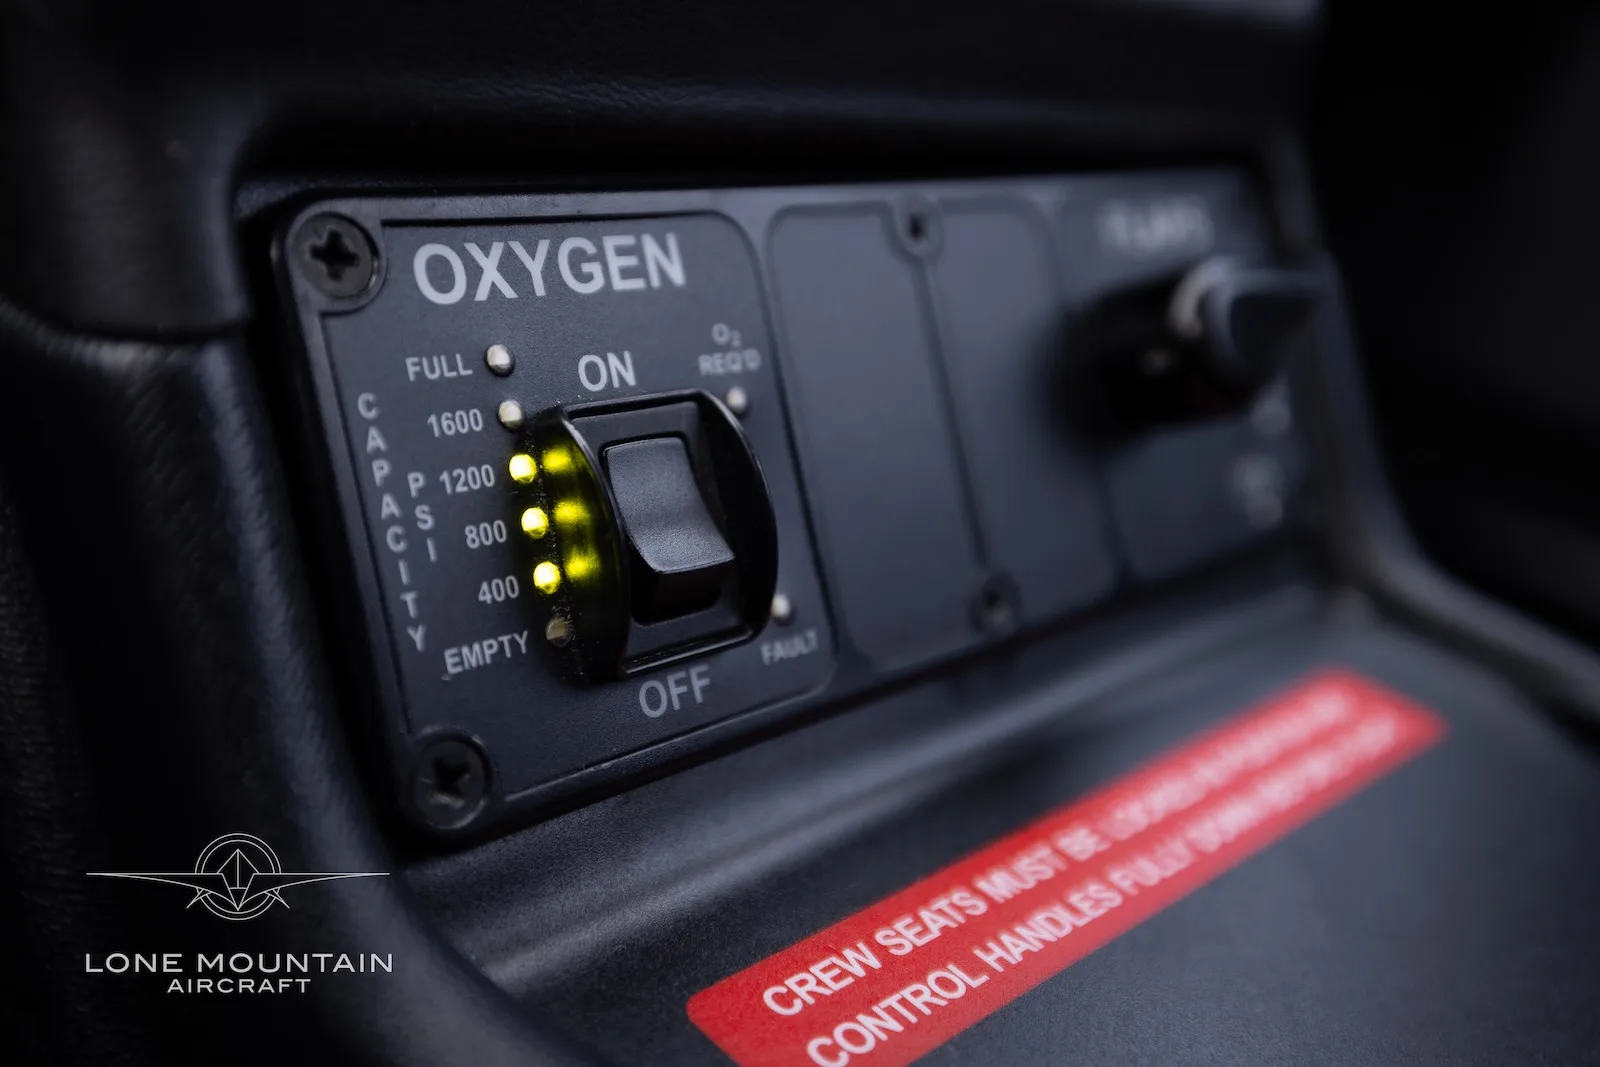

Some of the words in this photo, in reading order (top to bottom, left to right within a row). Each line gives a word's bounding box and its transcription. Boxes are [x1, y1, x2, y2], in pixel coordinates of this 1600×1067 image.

[413, 232, 686, 305] OXYGEN
[406, 353, 473, 382] FULL
[577, 350, 637, 391] ON
[427, 408, 484, 437] 1600
[439, 464, 496, 495] 1200
[464, 520, 508, 549] 800
[478, 575, 519, 604] 400
[443, 630, 530, 675] EMPTY
[760, 631, 819, 665] FAULT
[638, 665, 712, 718] OFF
[763, 942, 882, 1016] CREW
[874, 886, 988, 956] SEATS
[972, 842, 1067, 904] MUST
[806, 964, 990, 1067] CONTROL
[973, 880, 1123, 973] HANDLES
